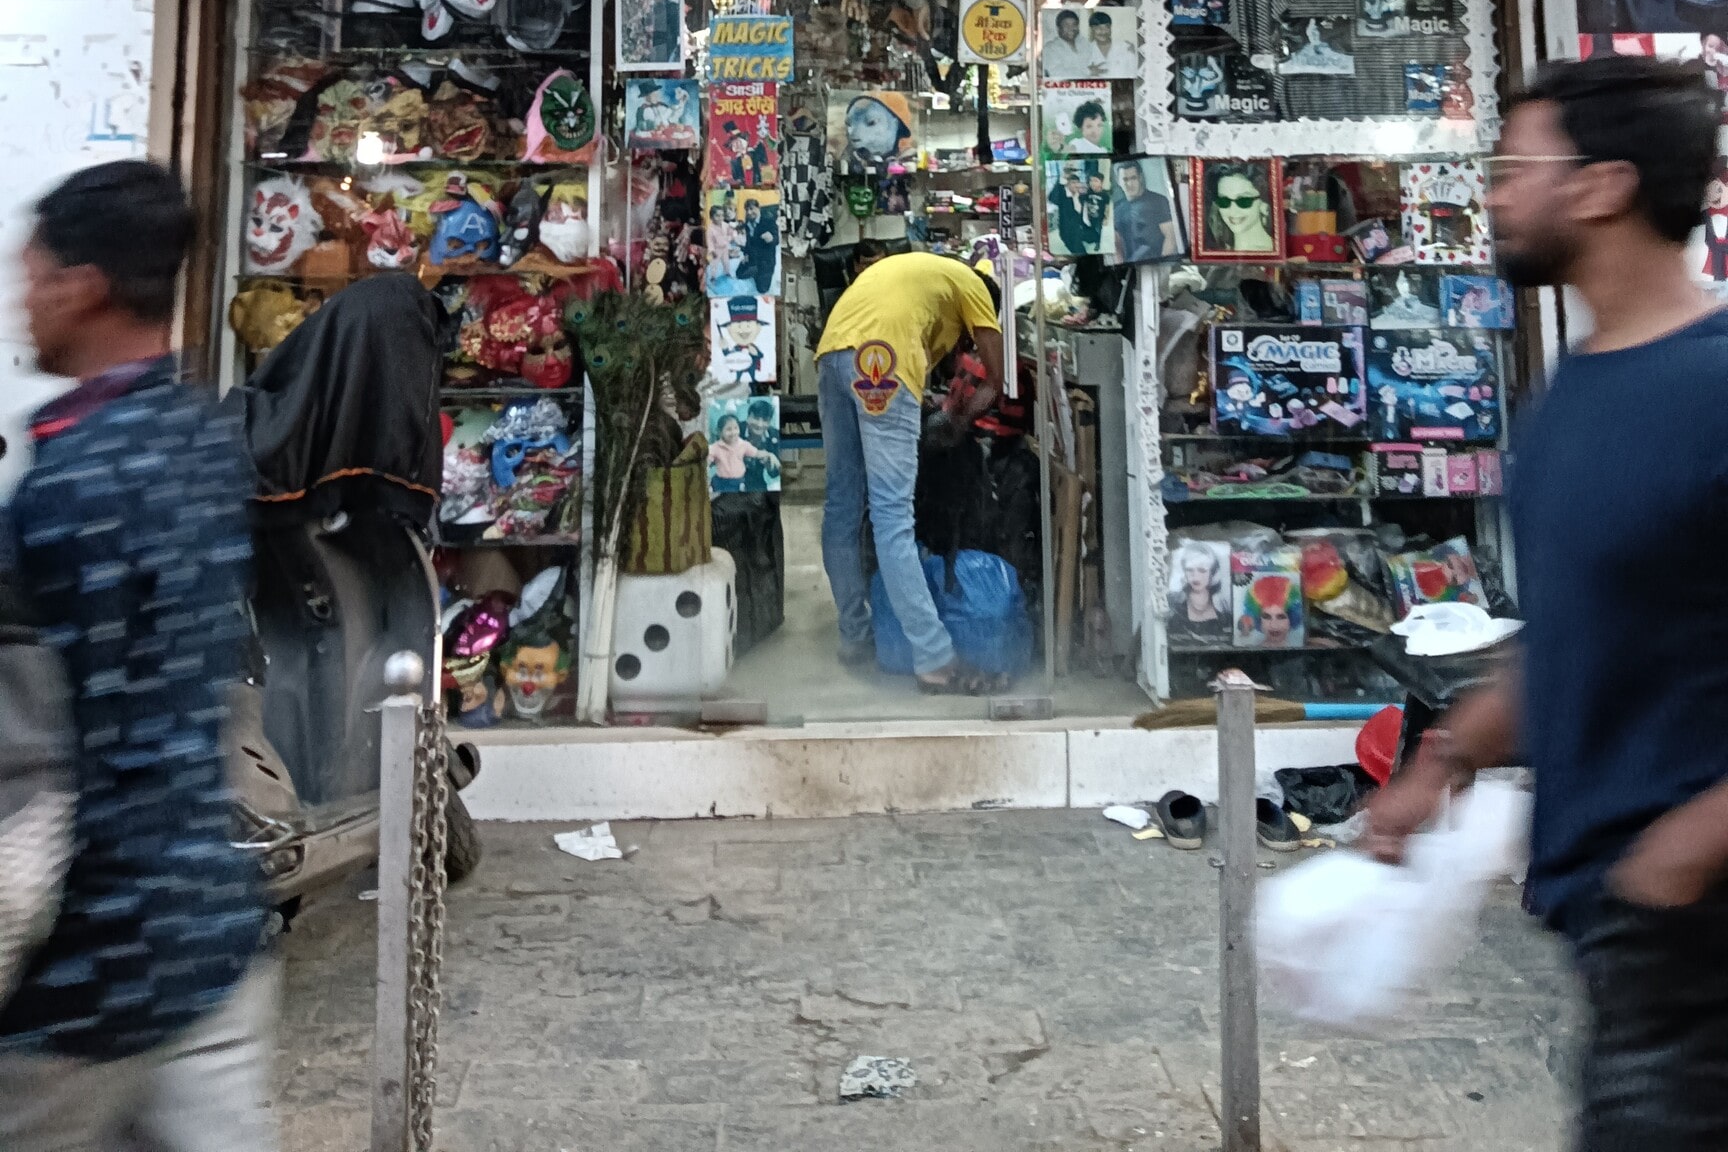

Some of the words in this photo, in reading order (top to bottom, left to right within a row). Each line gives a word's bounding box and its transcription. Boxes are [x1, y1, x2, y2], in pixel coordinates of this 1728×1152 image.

[1173, 4, 1207, 17] Magic
[712, 21, 790, 44] MAGIC
[1395, 16, 1450, 35] Magic
[712, 56, 792, 79] TRICKS
[1214, 94, 1270, 114] Magic
[1001, 188, 1012, 240] PUSH
[1265, 344, 1339, 359] MAGIC
